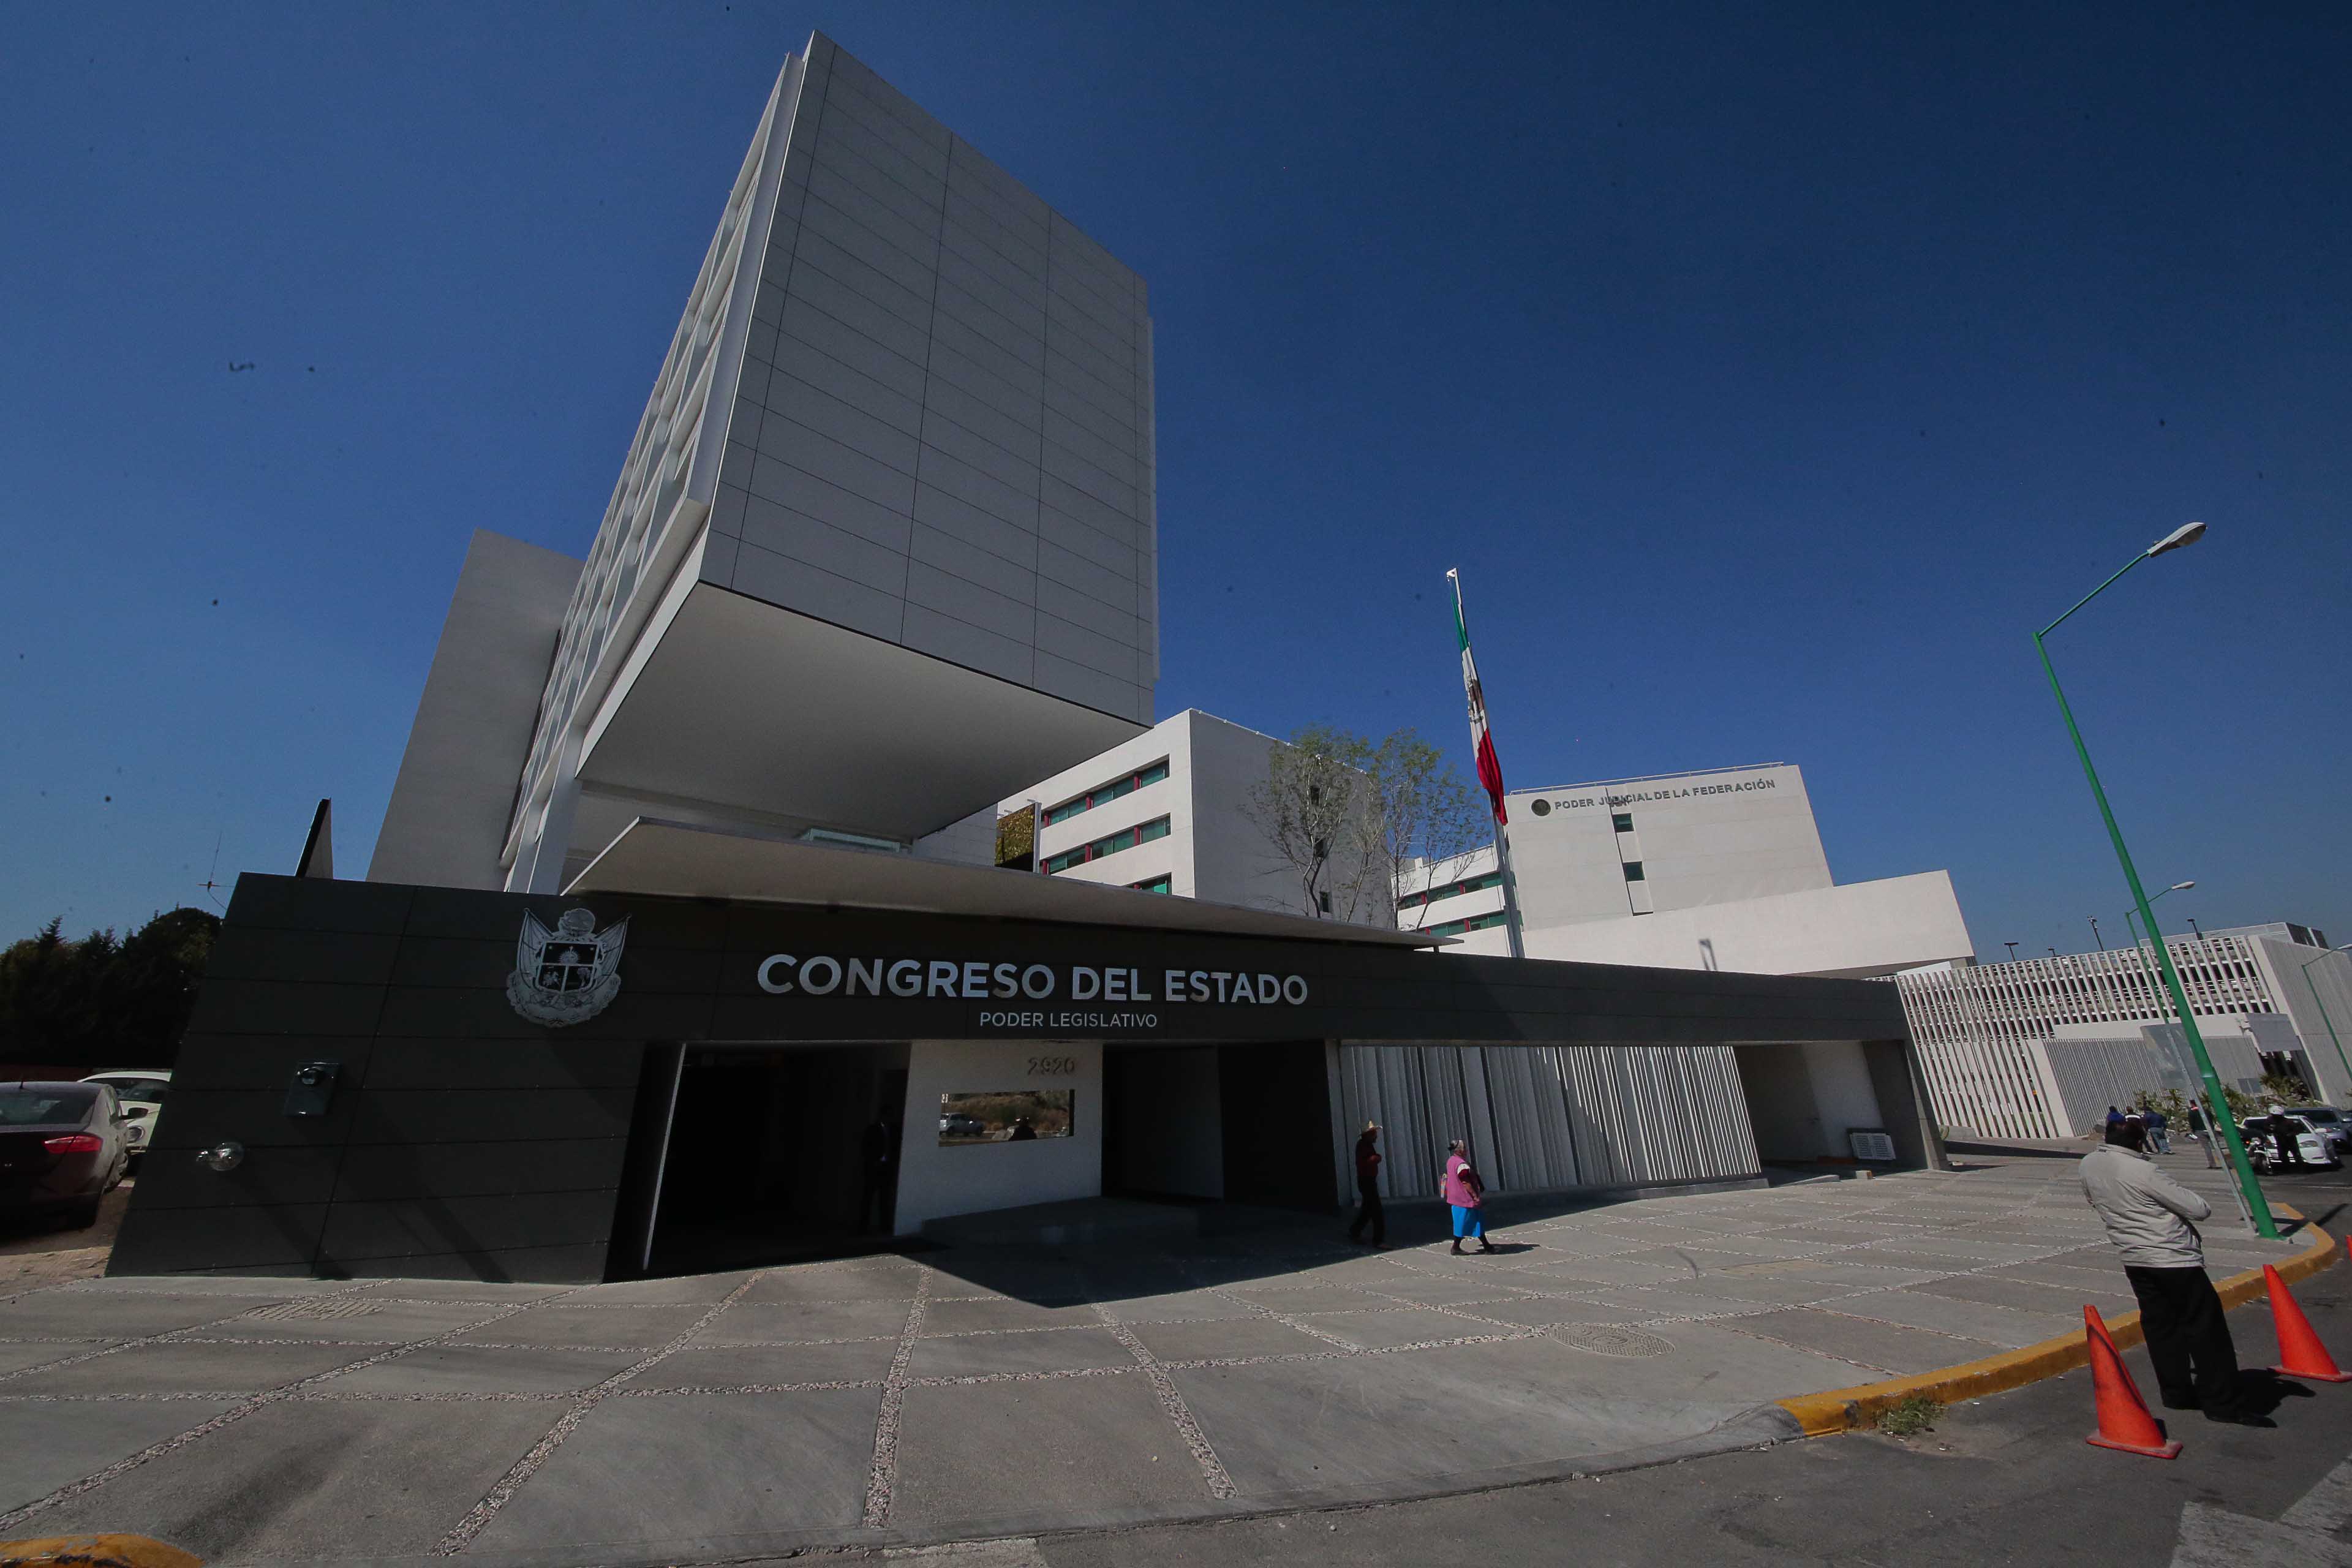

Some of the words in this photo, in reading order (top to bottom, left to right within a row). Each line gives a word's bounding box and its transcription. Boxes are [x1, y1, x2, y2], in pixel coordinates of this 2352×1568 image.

[1555, 799, 1595, 810] PODER
[1599, 793, 1653, 807] JUDICIAL
[1654, 790, 1670, 800] DE
[1673, 788, 1691, 798] LA
[1693, 778, 1776, 796] FEDERACIÓN
[758, 954, 1055, 999] CONGRESO
[1072, 967, 1152, 1001] DEL
[1166, 970, 1308, 1005] ESTADO
[980, 1012, 1044, 1027] PODER
[1050, 1013, 1158, 1028] LEGISLATIVO
[1027, 1057, 1076, 1076] 2920
